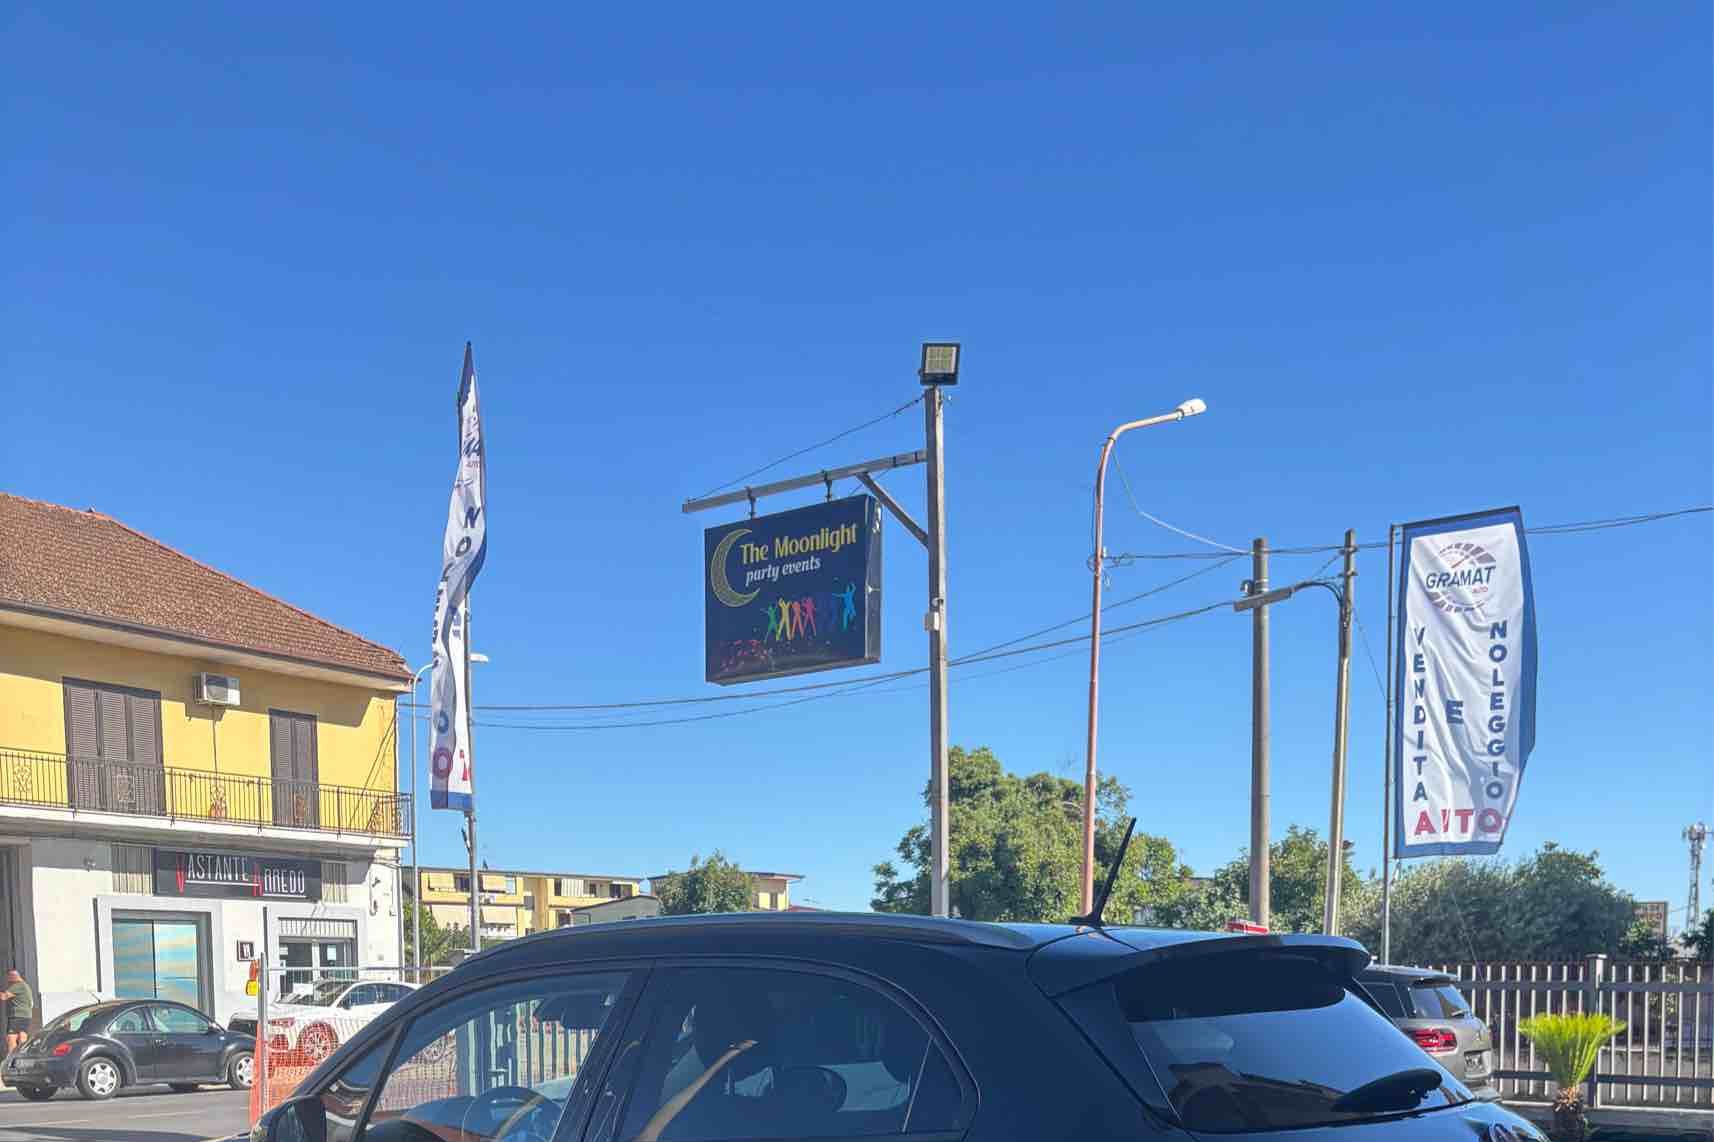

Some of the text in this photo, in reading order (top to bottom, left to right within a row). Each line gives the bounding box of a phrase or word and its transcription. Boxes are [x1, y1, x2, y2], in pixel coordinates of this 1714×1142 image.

[740, 523, 857, 564] The Moonlight
[745, 555, 822, 587] party events
[1425, 566, 1496, 590] GRAMAT
[1413, 627, 1429, 802] VENDITA
[1446, 700, 1464, 725] E
[1486, 620, 1508, 799] NOLEGGIO
[176, 851, 305, 896] VASTANTE ARREDO
